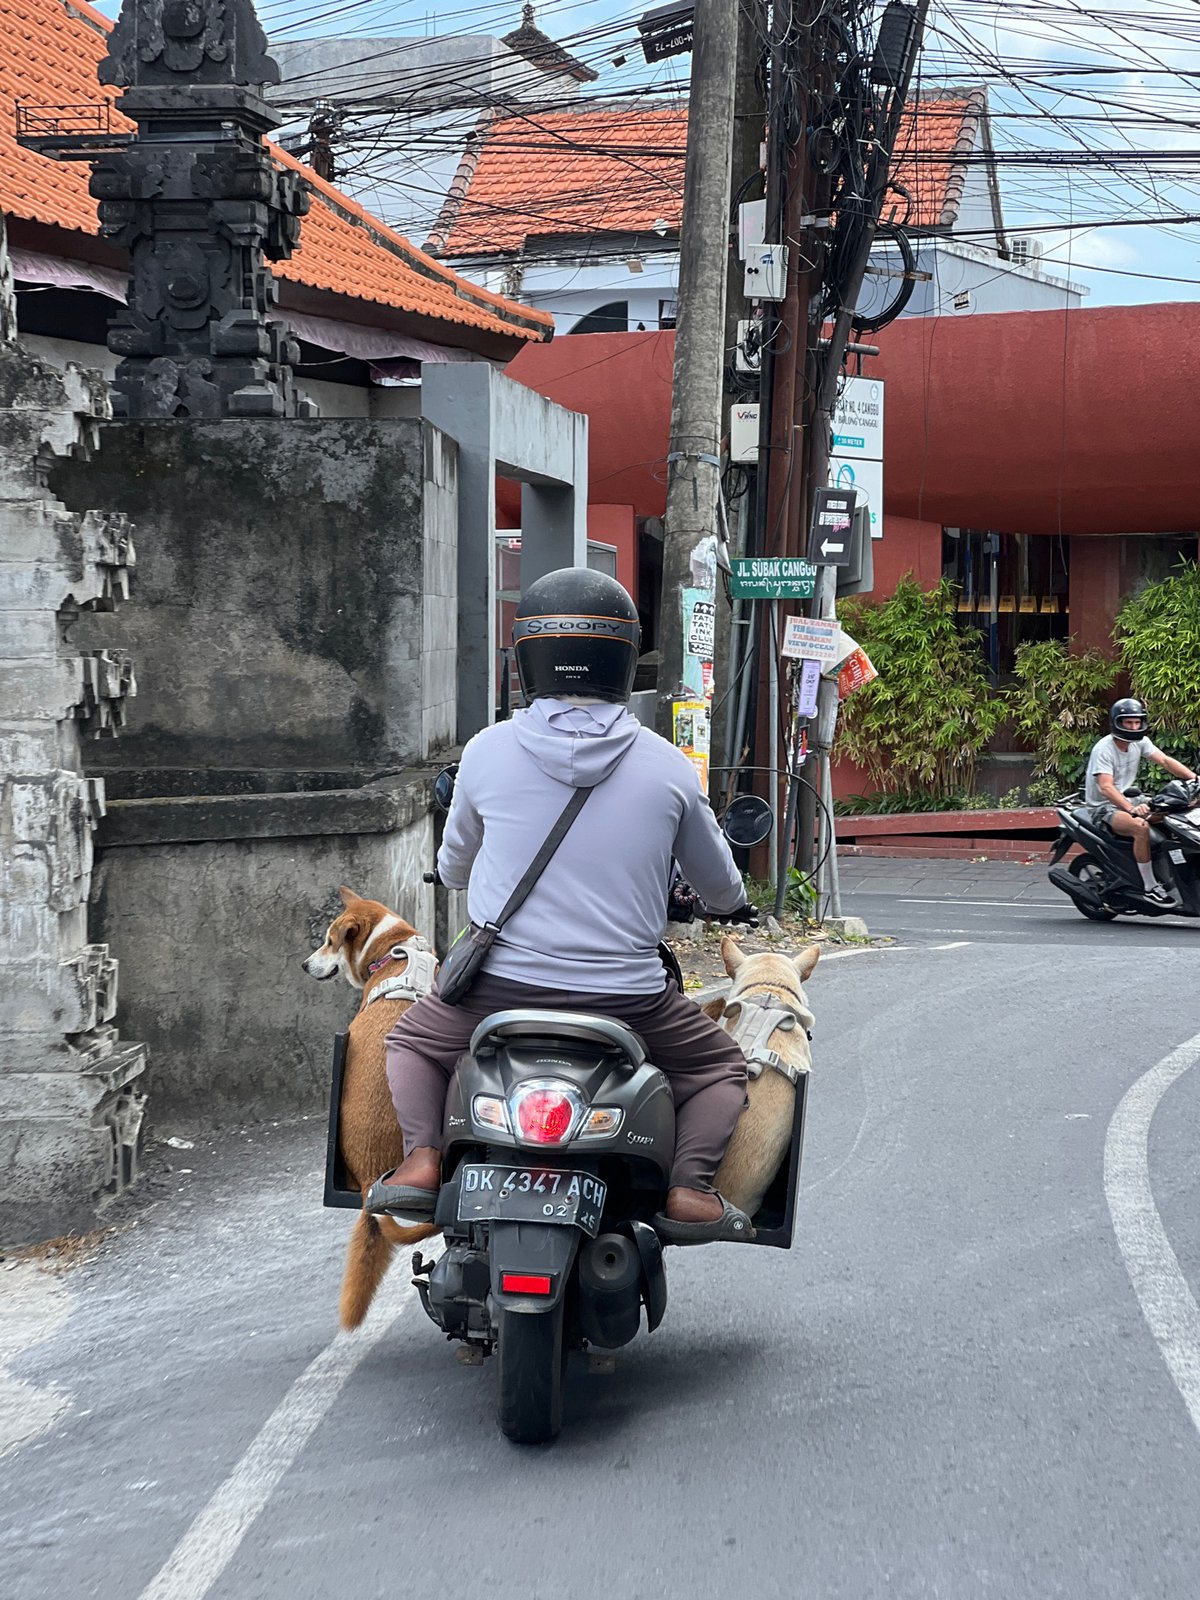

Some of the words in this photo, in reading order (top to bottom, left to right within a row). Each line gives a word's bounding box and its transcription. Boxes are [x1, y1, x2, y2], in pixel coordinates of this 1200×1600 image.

[737, 562, 750, 577] JL.
[752, 561, 780, 577] SUBAK
[782, 561, 818, 577] CANGGU
[695, 628, 711, 636] INK
[787, 639, 807, 647] VIEW
[808, 643, 835, 651] OCEAN
[535, 1057, 572, 1067] HONDA
[465, 1168, 494, 1191] DK
[503, 1171, 561, 1194] 4347
[567, 1175, 603, 1207] ACH
[542, 1203, 567, 1217] 02
